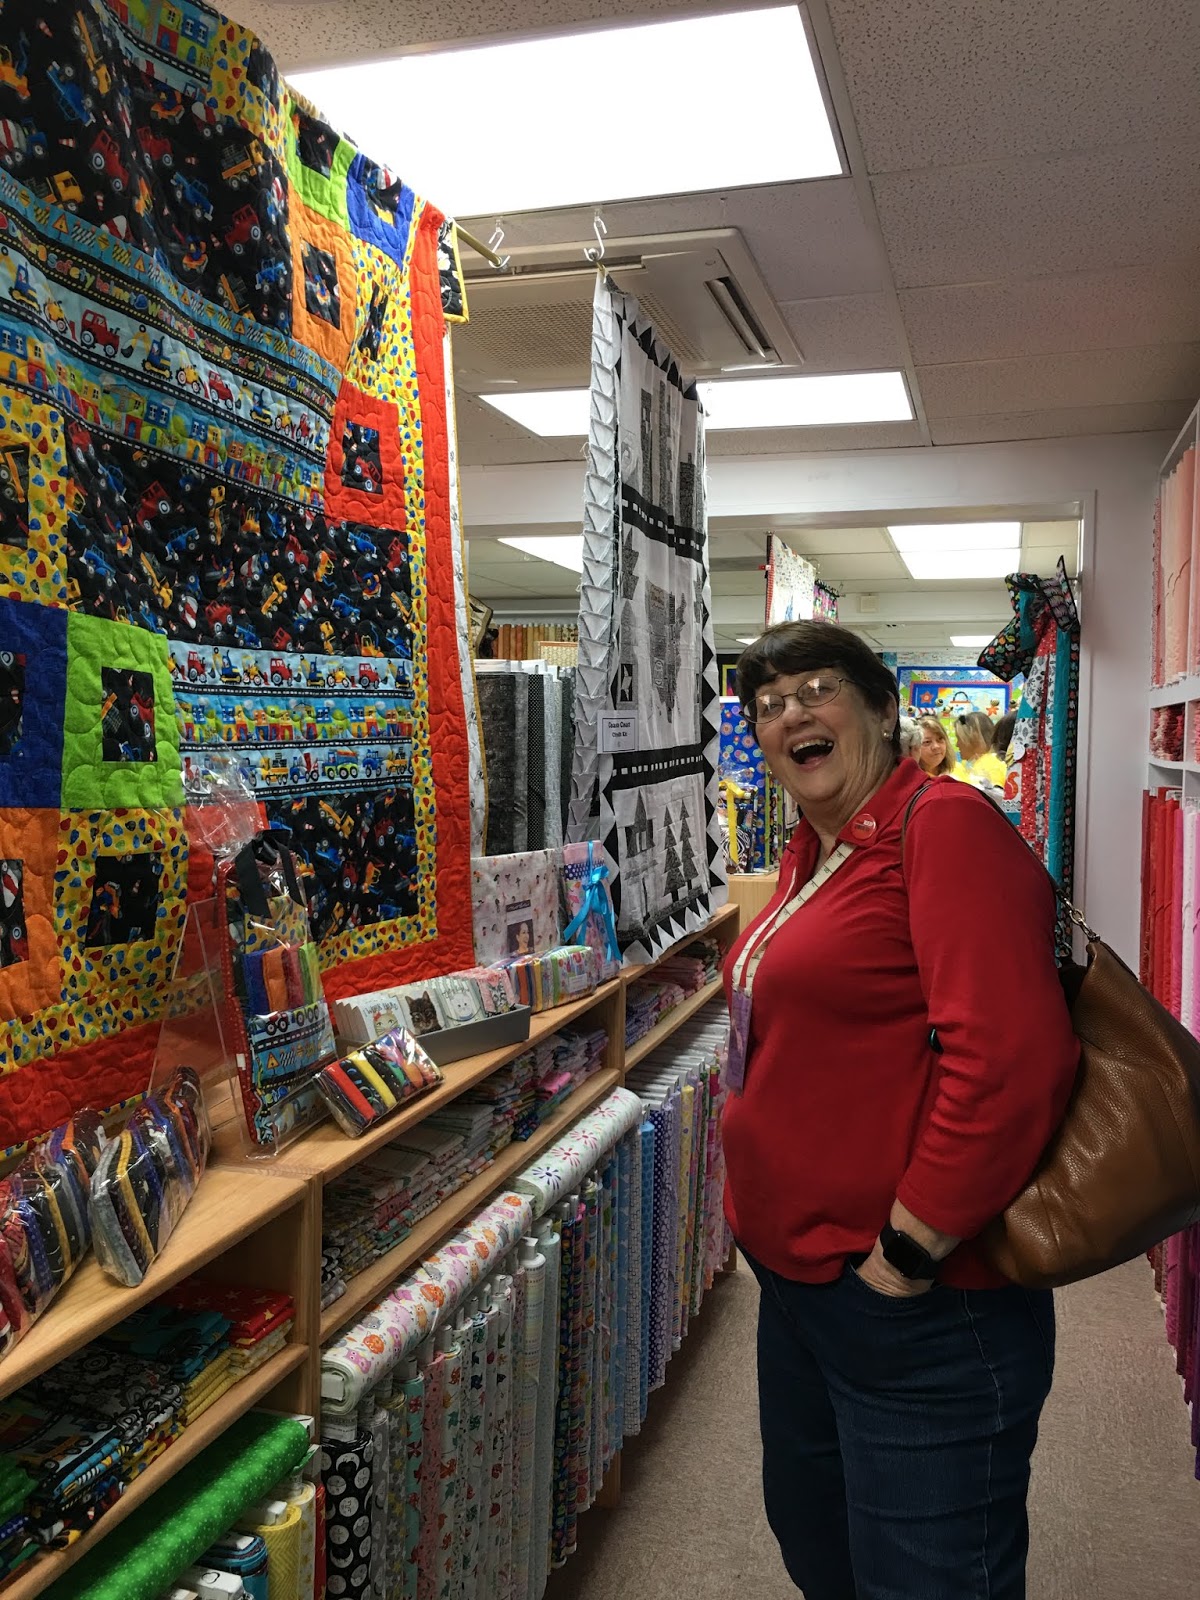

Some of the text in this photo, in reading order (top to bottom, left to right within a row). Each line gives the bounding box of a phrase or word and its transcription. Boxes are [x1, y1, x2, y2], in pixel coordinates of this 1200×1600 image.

[47, 252, 95, 289] Safety
[96, 273, 137, 306] helmet
[232, 350, 266, 377] Safety
